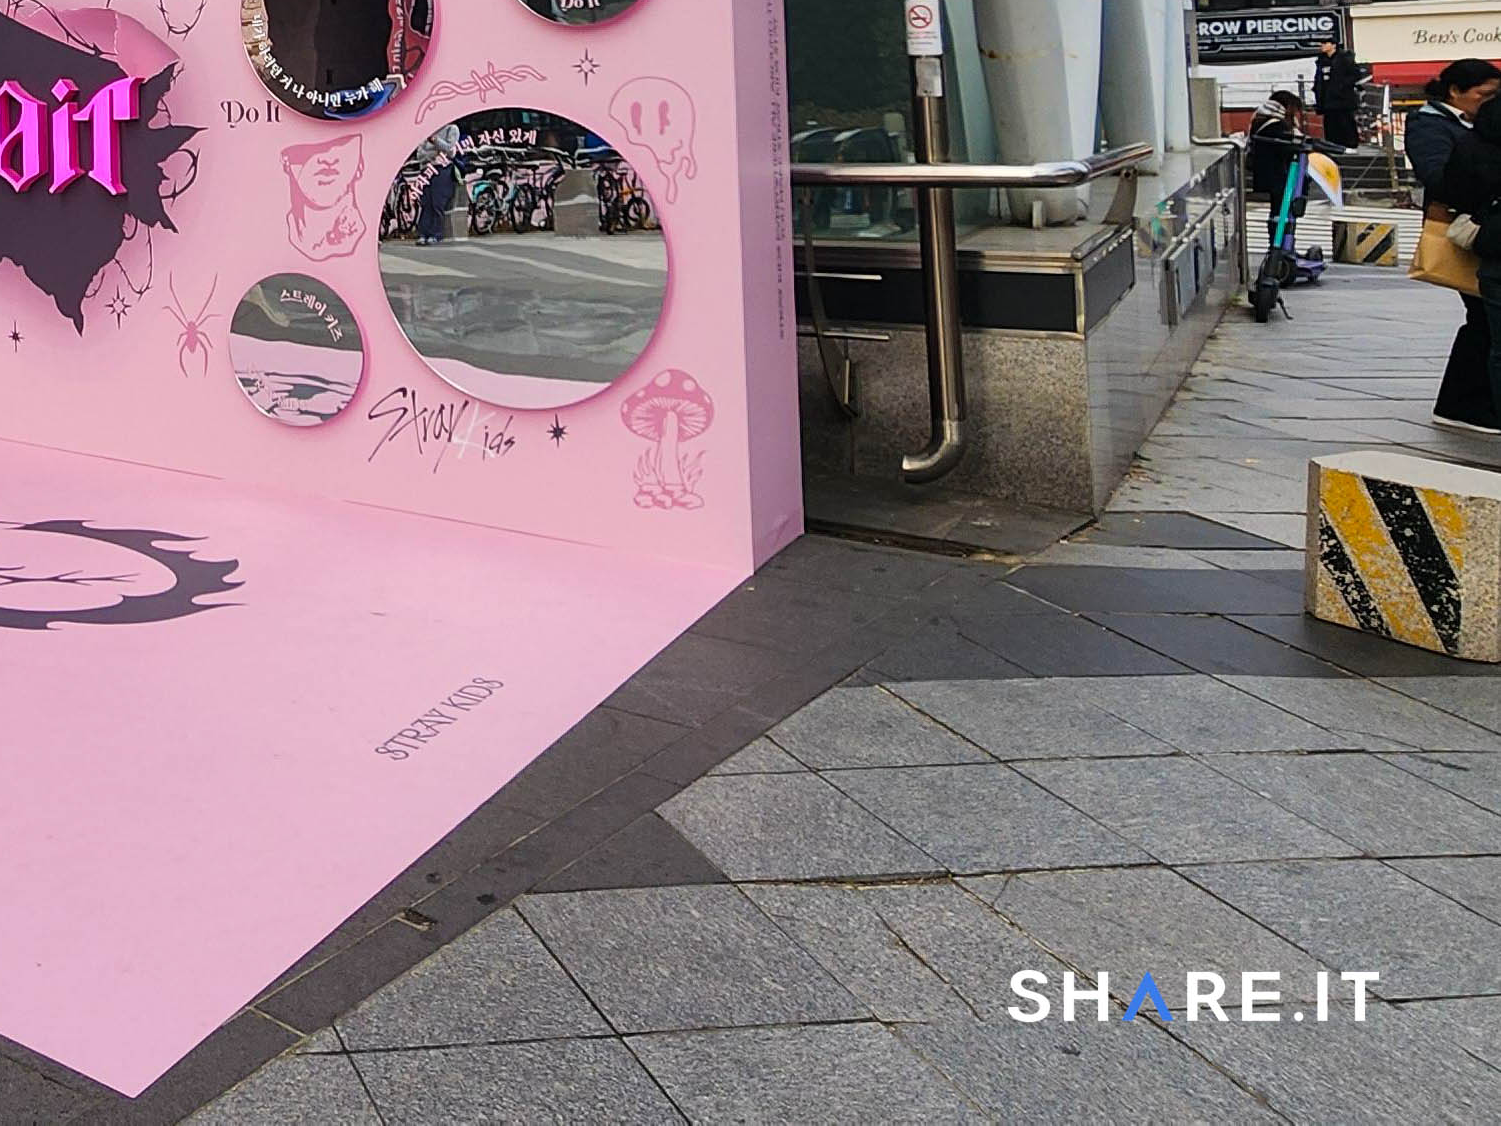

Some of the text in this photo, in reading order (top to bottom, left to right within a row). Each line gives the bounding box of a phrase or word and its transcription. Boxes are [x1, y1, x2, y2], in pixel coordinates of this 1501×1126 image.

[1246, 16, 1334, 34] PIERCING
[1412, 29, 1457, 44] Ben's
[220, 100, 281, 128] Do It
[478, 130, 505, 146] 자신
[280, 288, 344, 343] 스트레이 키즈
[368, 387, 516, 474] Stray Kids
[374, 677, 504, 761] STRAY KIDS
